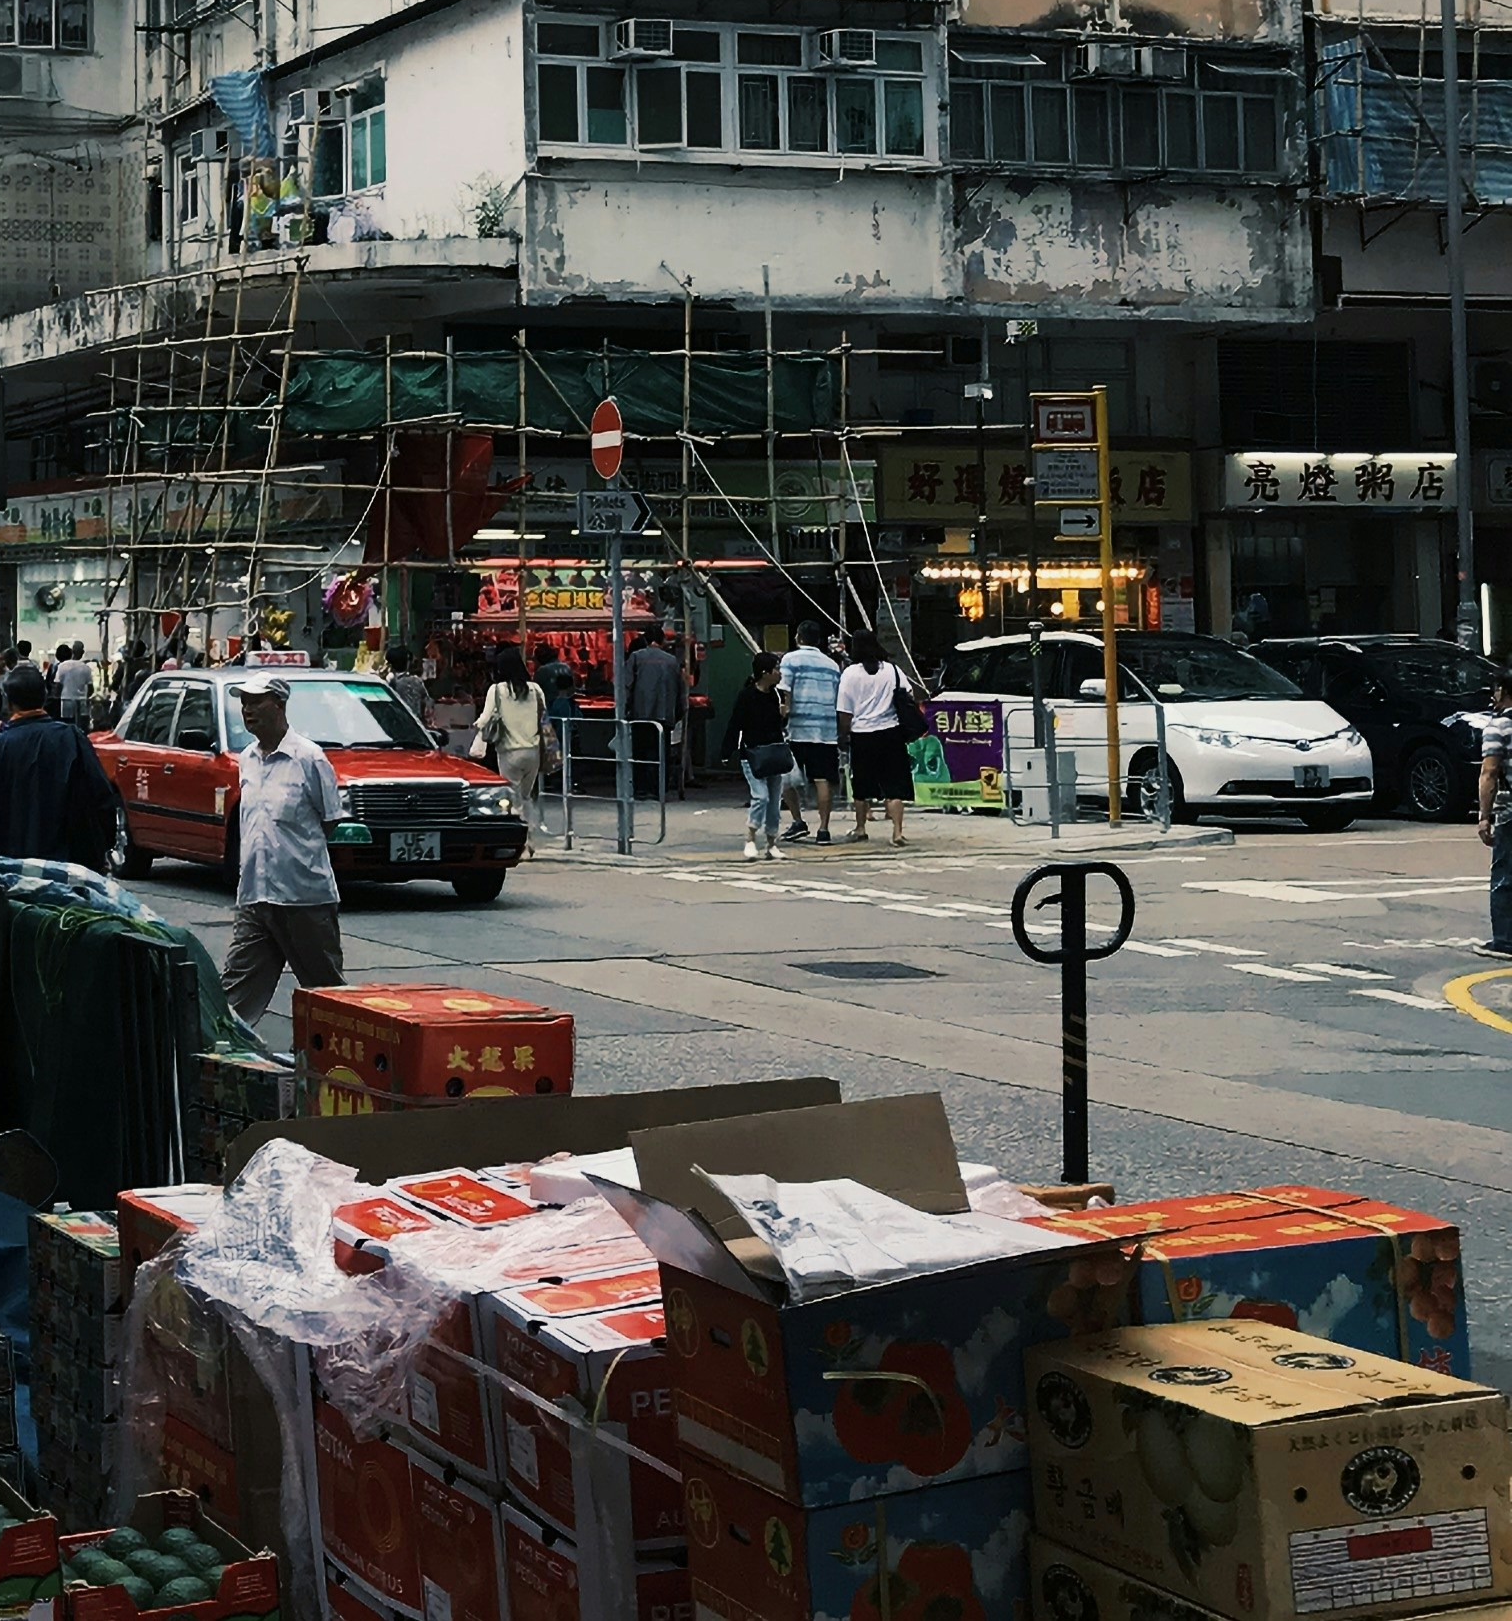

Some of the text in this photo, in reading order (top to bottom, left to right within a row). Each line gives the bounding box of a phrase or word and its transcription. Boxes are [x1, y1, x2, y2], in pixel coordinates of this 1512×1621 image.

[1244, 461, 1446, 503] 亮燈粥店
[254, 652, 305, 665] TAXI
